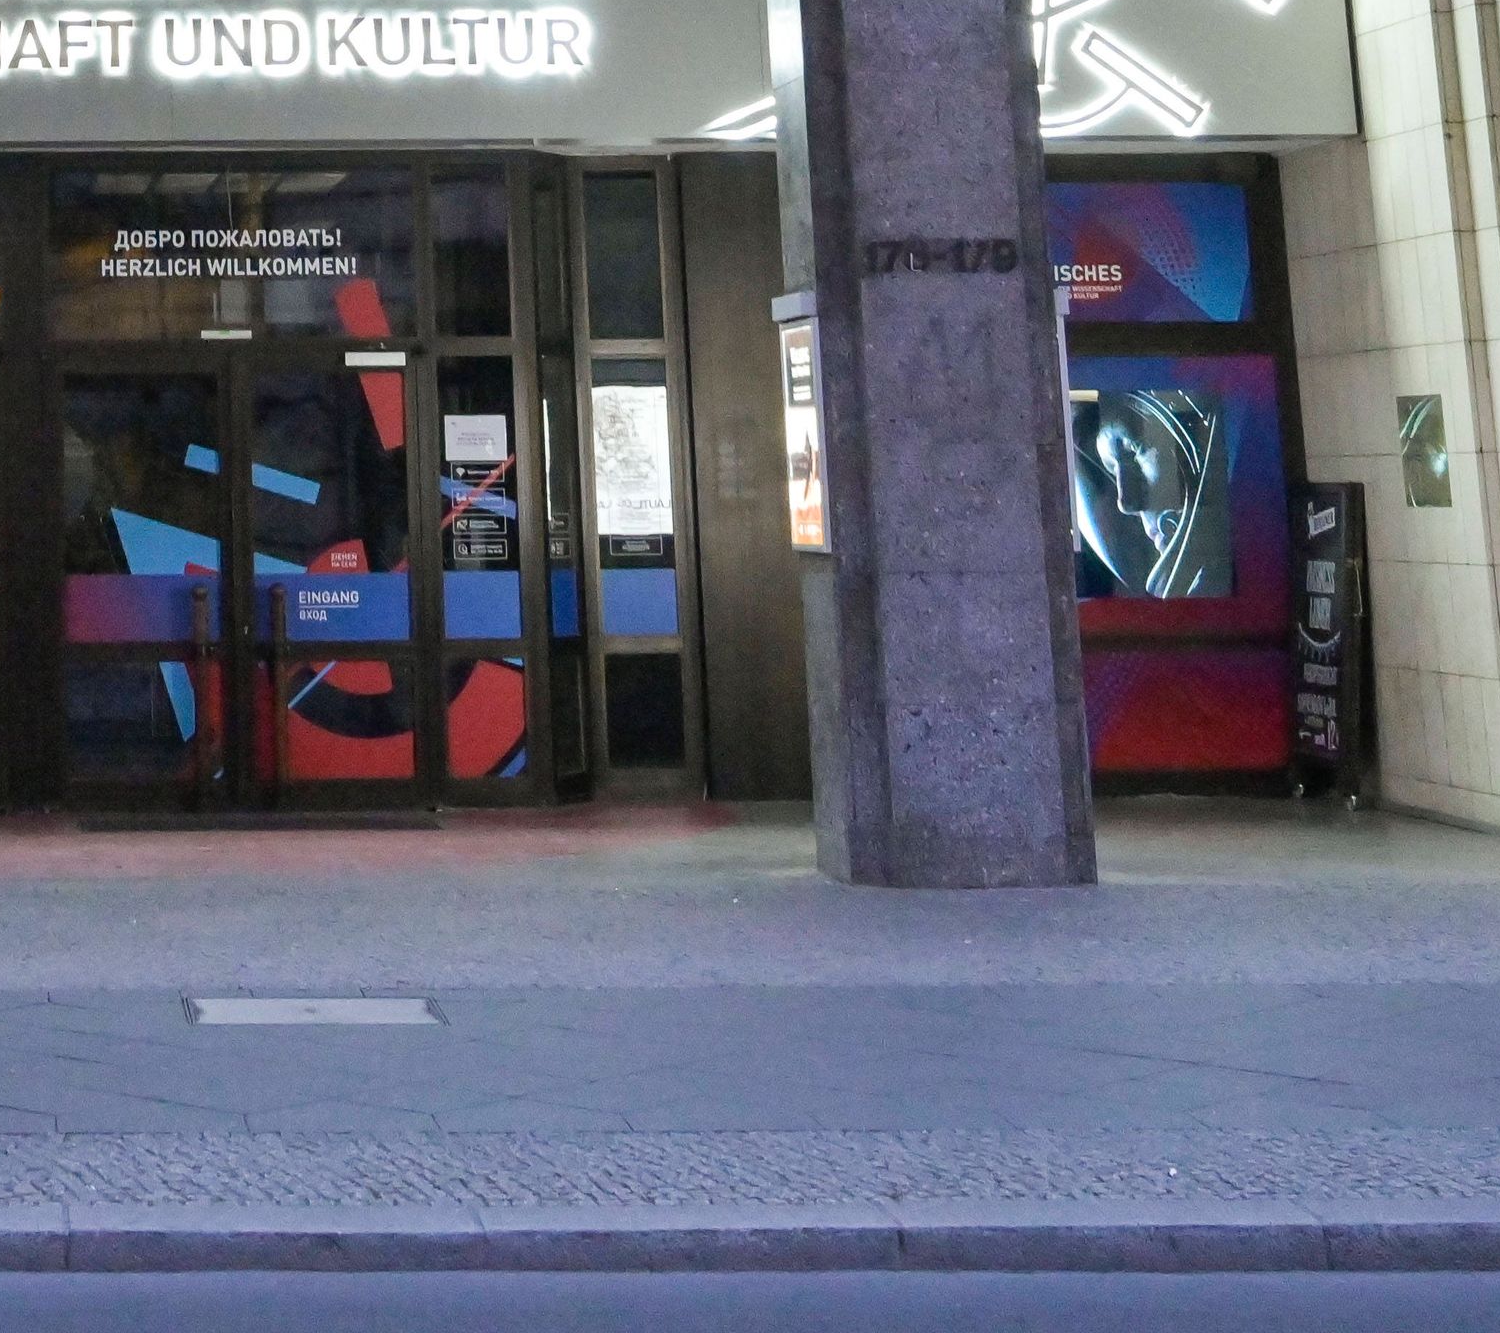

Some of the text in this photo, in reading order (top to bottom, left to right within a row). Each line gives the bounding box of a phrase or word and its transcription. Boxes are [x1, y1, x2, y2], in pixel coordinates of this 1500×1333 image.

[164, 17, 301, 68] UND
[327, 16, 585, 68] KULTUR
[114, 228, 342, 252] ДОБРО ПОЖАЛОВАТЬ!
[101, 256, 358, 277] HERZLICH WILLKOMMEN!
[298, 590, 360, 604] EINGANG
